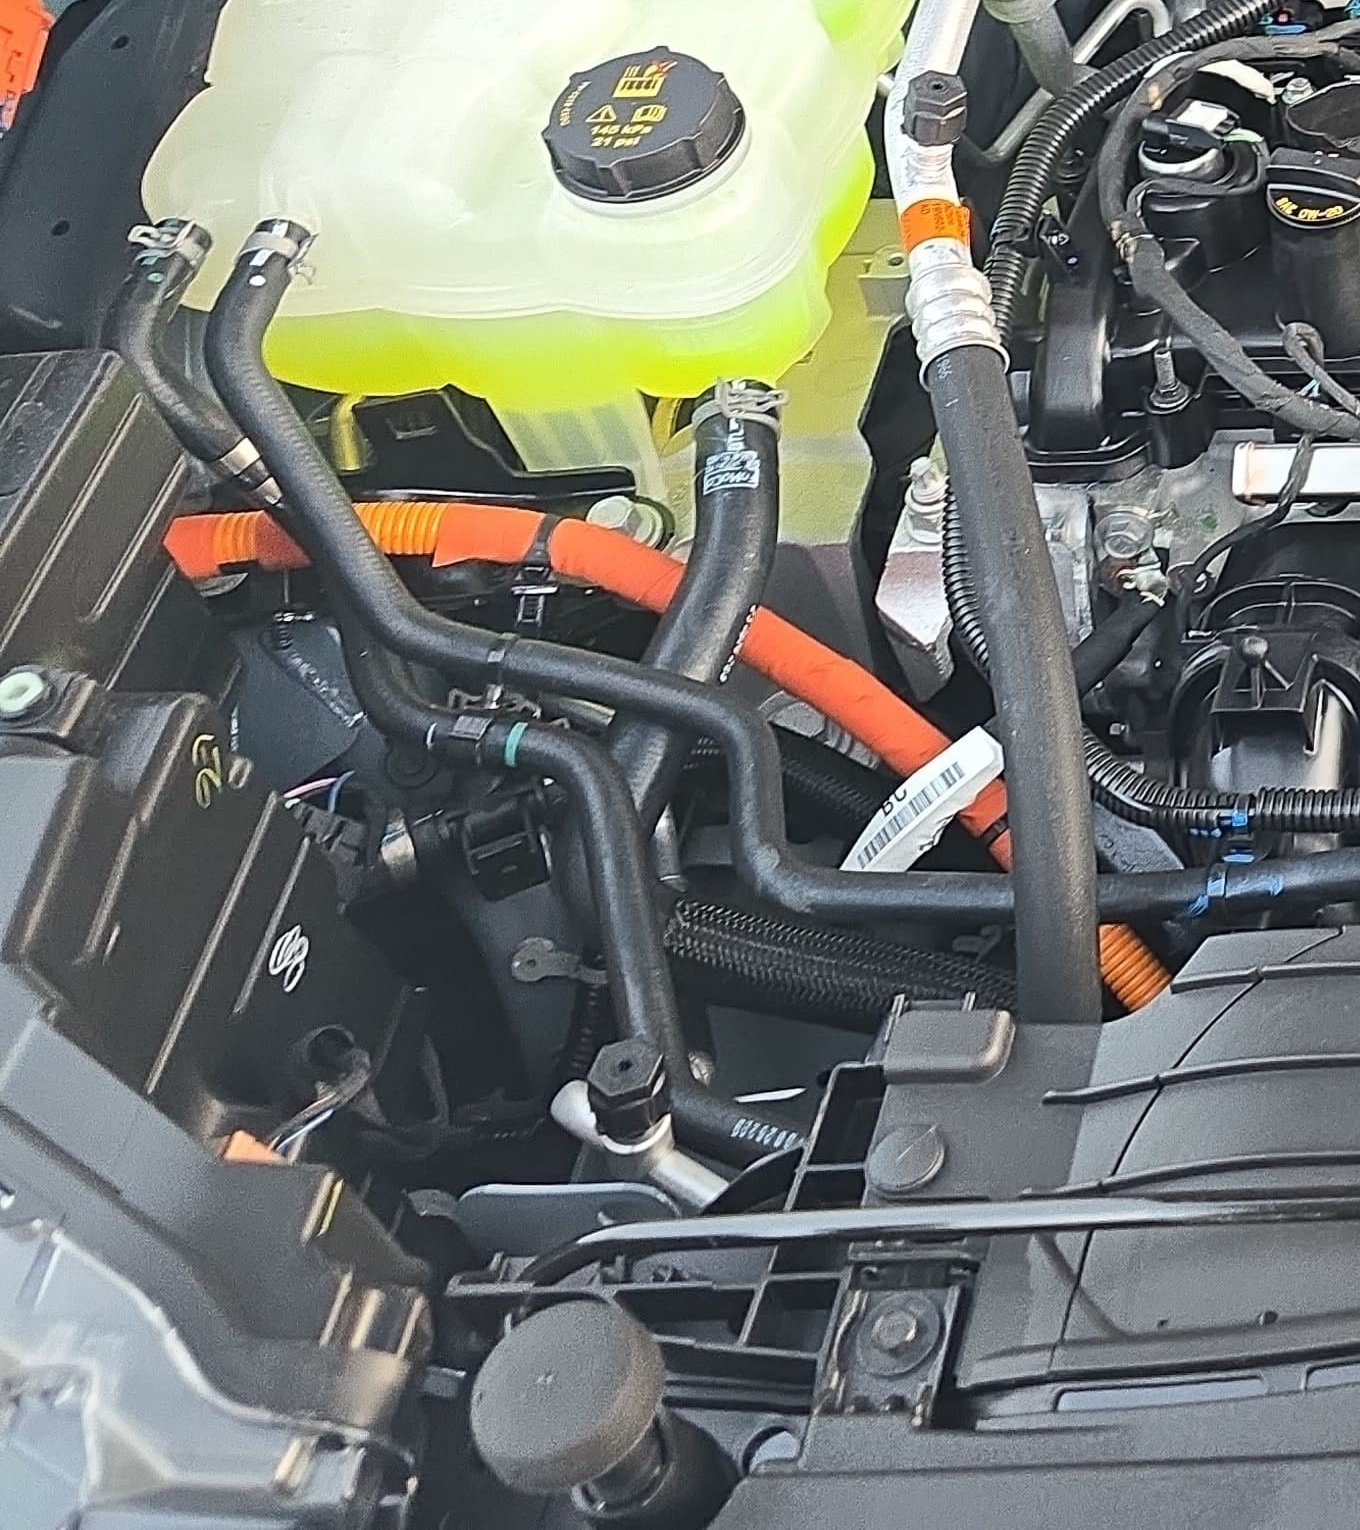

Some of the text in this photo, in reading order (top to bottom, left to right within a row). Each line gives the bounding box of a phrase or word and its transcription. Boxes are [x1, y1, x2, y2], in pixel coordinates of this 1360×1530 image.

[591, 124, 653, 135] 145 kPa
[591, 136, 641, 148] 21 psi
